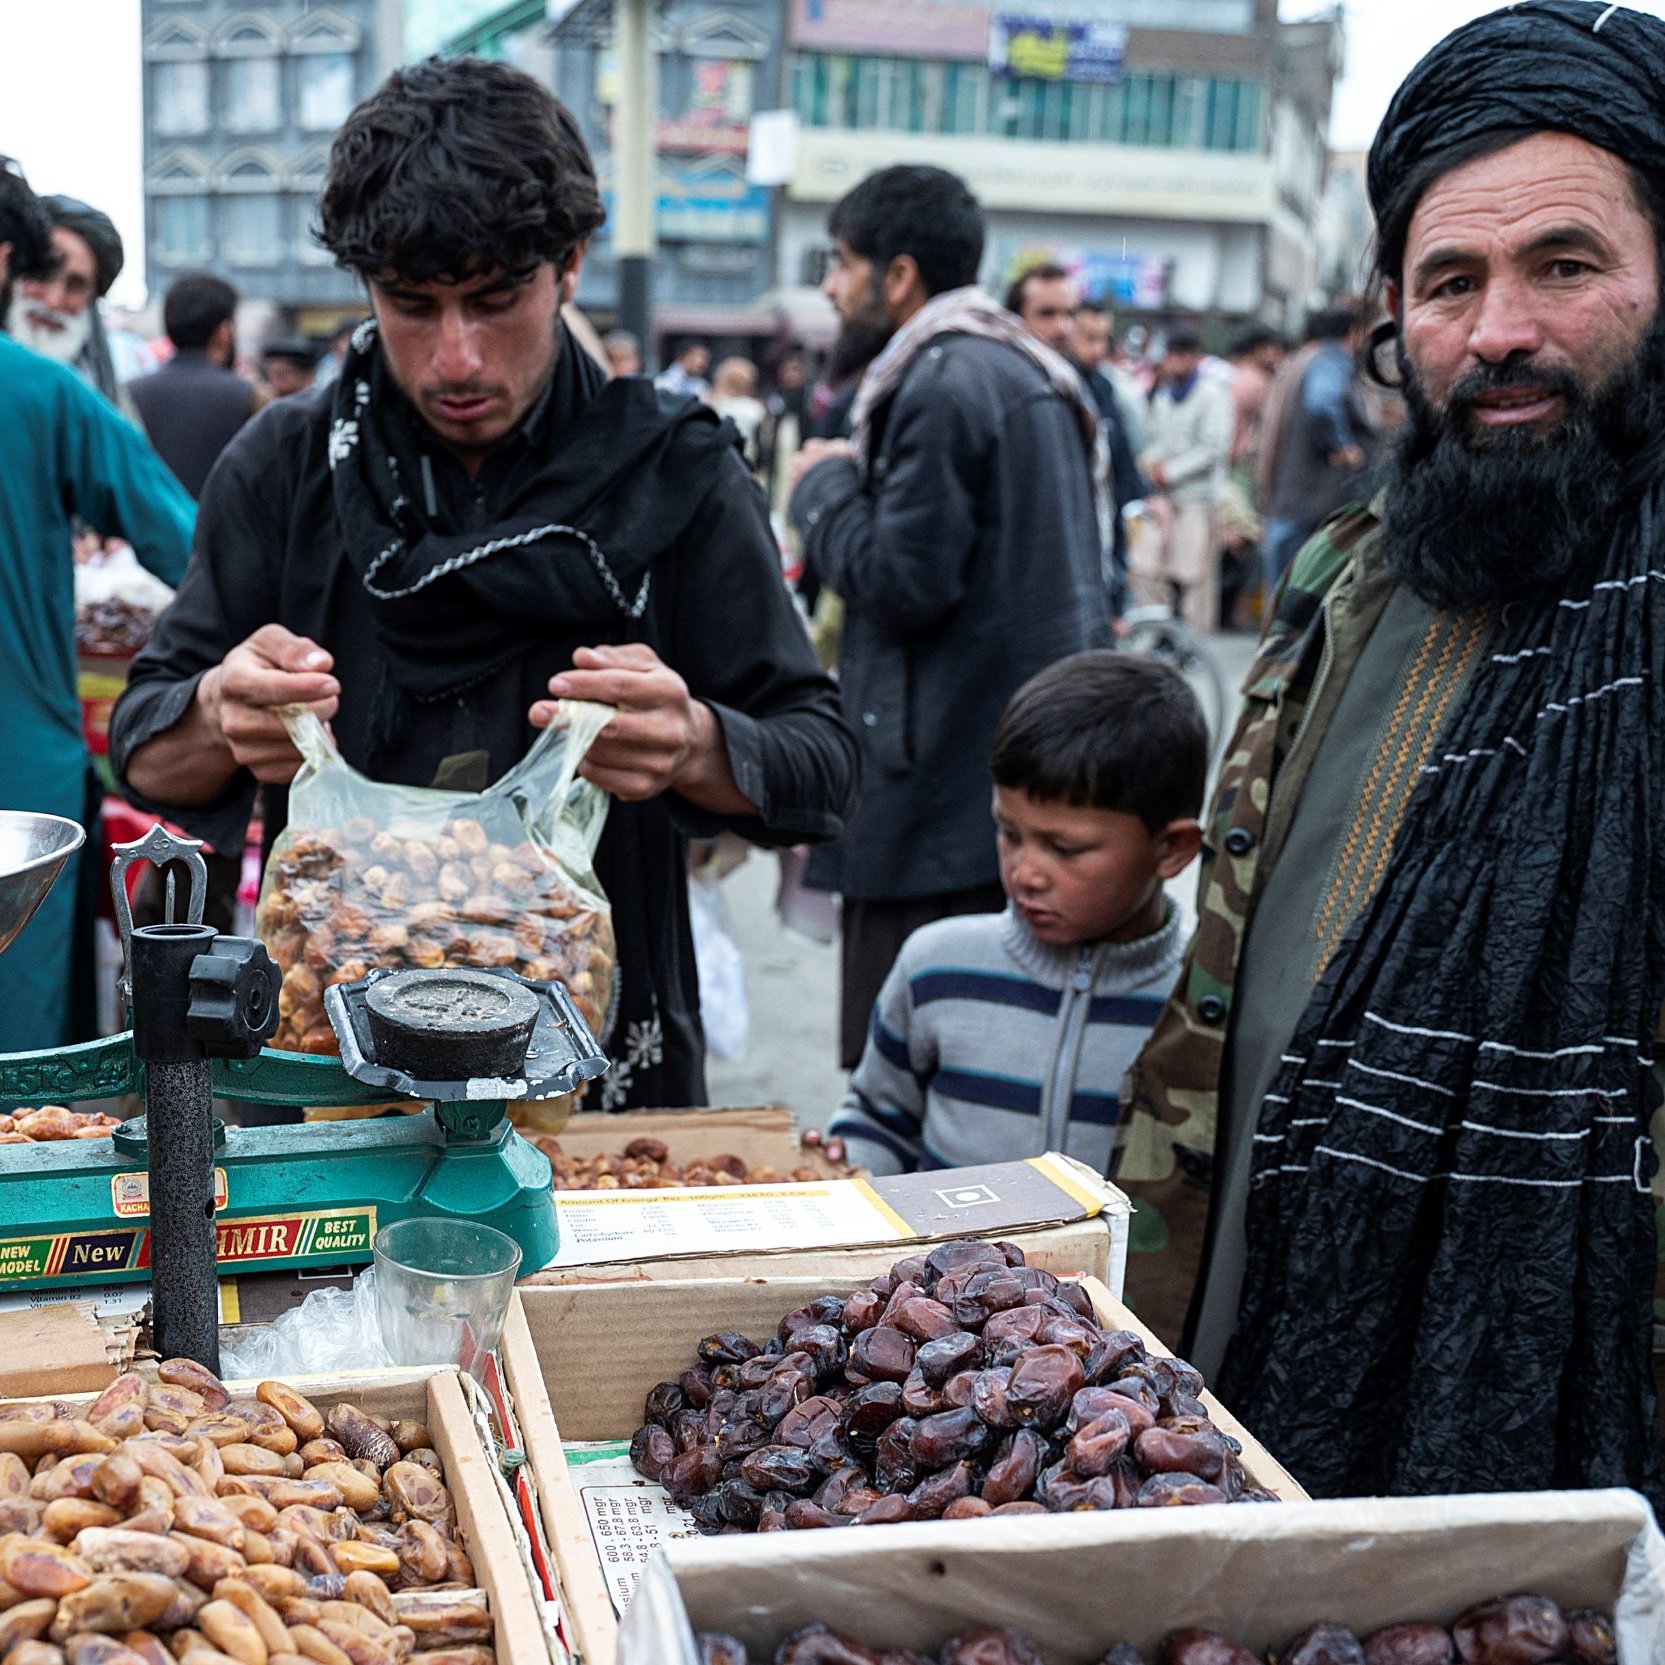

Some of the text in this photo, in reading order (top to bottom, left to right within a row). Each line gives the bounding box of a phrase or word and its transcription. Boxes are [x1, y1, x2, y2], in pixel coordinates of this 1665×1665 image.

[120, 1202, 150, 1214] KACHA
[324, 1220, 357, 1234] BEST
[216, 1225, 288, 1257] HMIR
[315, 1234, 366, 1250] QUALITY
[1, 1246, 31, 1259] NEW
[72, 1243, 125, 1264] New
[30, 1295, 67, 1303] Vitamin
[594, 1496, 608, 1517] mgr
[609, 1498, 622, 1516] mgr
[624, 1498, 637, 1516] mgr
[638, 1496, 652, 1514] mgr
[598, 1519, 613, 1537] 650
[613, 1518, 627, 1536] 67.8
[628, 1518, 643, 1536] 63.8
[644, 1524, 658, 1535] 51
[605, 1545, 620, 1563] 600
[620, 1543, 634, 1562] 58.3
